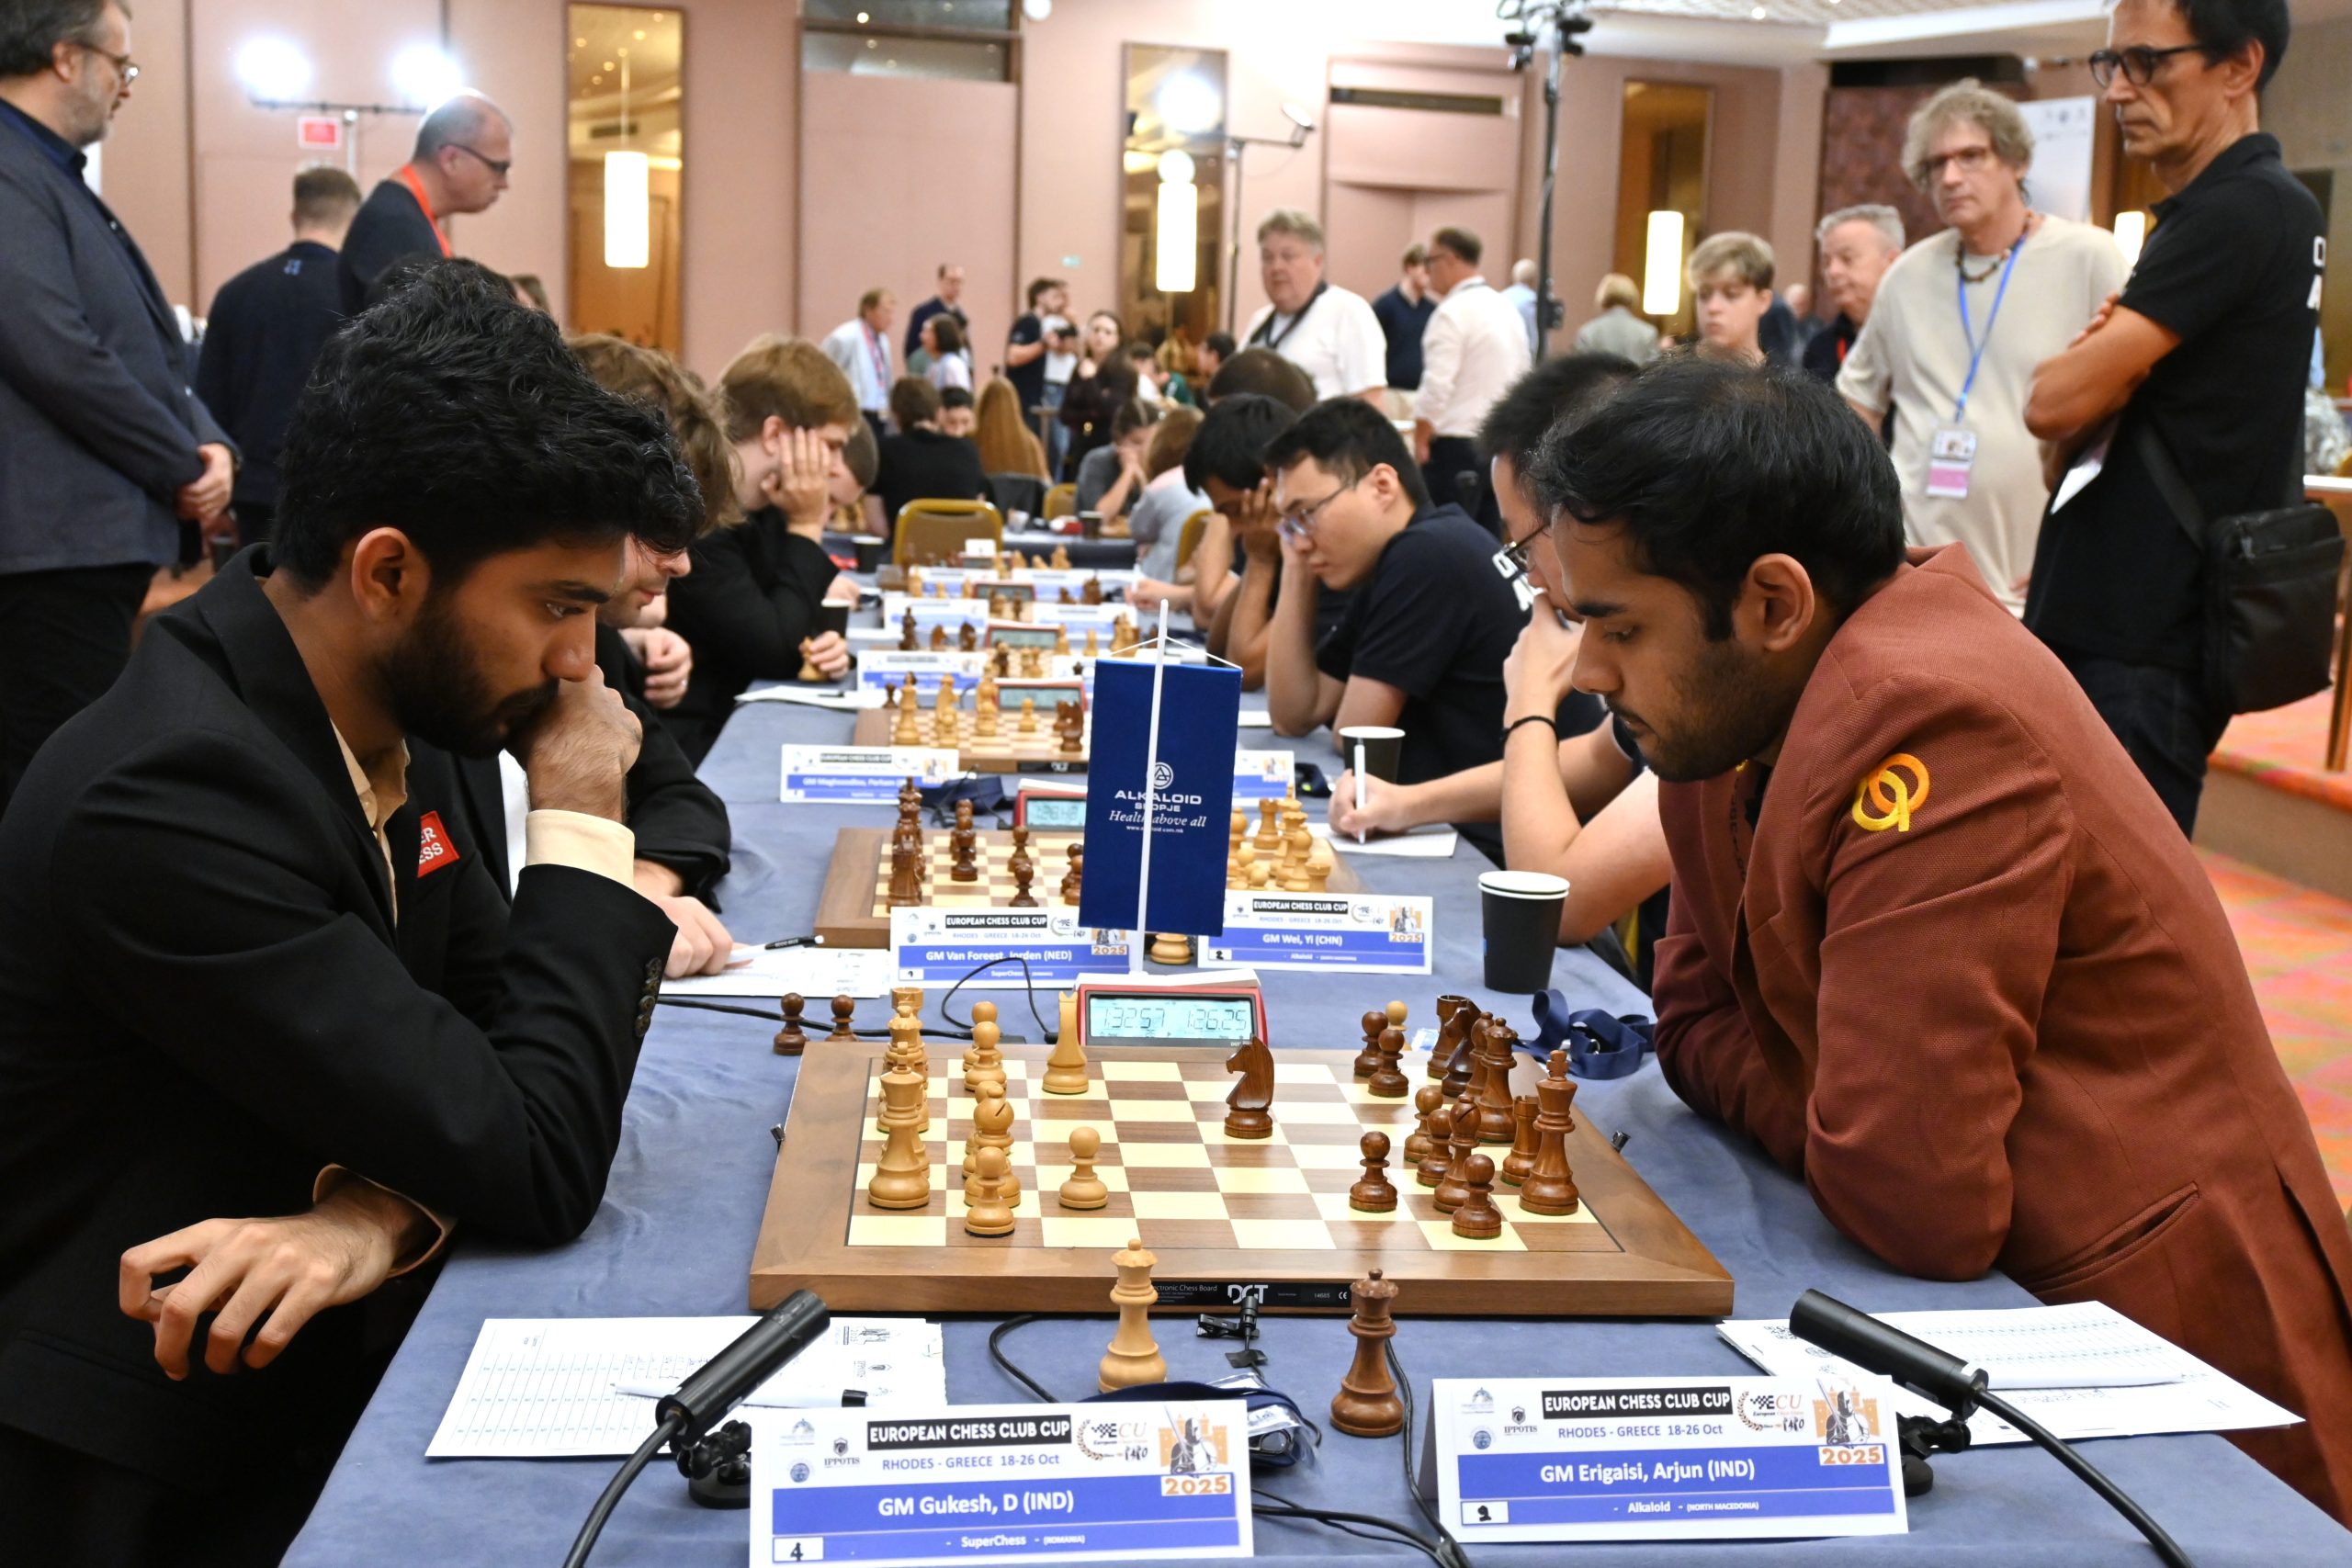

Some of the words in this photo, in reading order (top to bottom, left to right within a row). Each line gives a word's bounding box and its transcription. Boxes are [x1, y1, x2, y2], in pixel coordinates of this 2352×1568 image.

[1114, 790, 1202, 805] ALKALOID
[1135, 802, 1181, 812] SOPJE
[1152, 813, 1188, 826] above
[1190, 816, 1207, 827] all
[1253, 901, 1290, 910] EUROPEAN
[1291, 902, 1313, 911] CHESS
[1314, 903, 1332, 911] CLUB
[1333, 903, 1348, 912] CUP
[946, 917, 986, 926] EUROPEAN
[987, 917, 1010, 926] CHESS
[1011, 917, 1031, 925] CLUB
[1032, 917, 1046, 925] CUP
[1262, 934, 1281, 943] GM
[1282, 934, 1303, 945] Wei,
[1305, 935, 1314, 944] Yi
[1315, 934, 1343, 946] (CHN)
[1391, 933, 1421, 942] 2025
[926, 951, 944, 961] GM
[945, 951, 965, 961] Van
[1044, 950, 1072, 962] (NED)
[1093, 946, 1126, 955] 2025
[1227, 1283, 1269, 1304] DGT
[1544, 1395, 1616, 1412] EUROPEAN
[1619, 1393, 1662, 1409] CHESS
[1665, 1393, 1700, 1408] CLUB
[1702, 1392, 1731, 1407] CUP
[870, 1426, 947, 1443] EUROPEAN
[950, 1424, 996, 1440] CHESS
[999, 1422, 1037, 1438] CLUB
[1042, 1420, 1070, 1437] CUP
[1504, 1425, 1538, 1434] IPPOTIS
[1558, 1427, 1606, 1438] RHODES
[1617, 1425, 1661, 1437] GREECE
[1668, 1424, 1700, 1436] 18-26
[1702, 1424, 1723, 1436] Oct
[824, 1457, 861, 1467] IPPOTIS
[882, 1458, 934, 1470] RHODES
[945, 1455, 993, 1469] GREECE
[1001, 1454, 1035, 1466] 18-26
[1038, 1453, 1060, 1465] Oct
[1821, 1447, 1881, 1465] 2025
[1540, 1465, 1574, 1483] GM
[1578, 1462, 1648, 1484] Erigaisi,
[1653, 1461, 1703, 1483] Arjun
[1707, 1459, 1755, 1482] (IND)
[1164, 1475, 1227, 1495] 2025
[878, 1497, 915, 1516] GM
[919, 1493, 999, 1516] Gukesh,
[1003, 1494, 1019, 1512] D
[1023, 1489, 1074, 1515] (IND)
[1628, 1501, 1671, 1514] Alkaloid
[961, 1534, 1027, 1549] SuperChess
[1043, 1535, 1086, 1546] (ROMANIA)
[790, 1542, 804, 1562] 4
